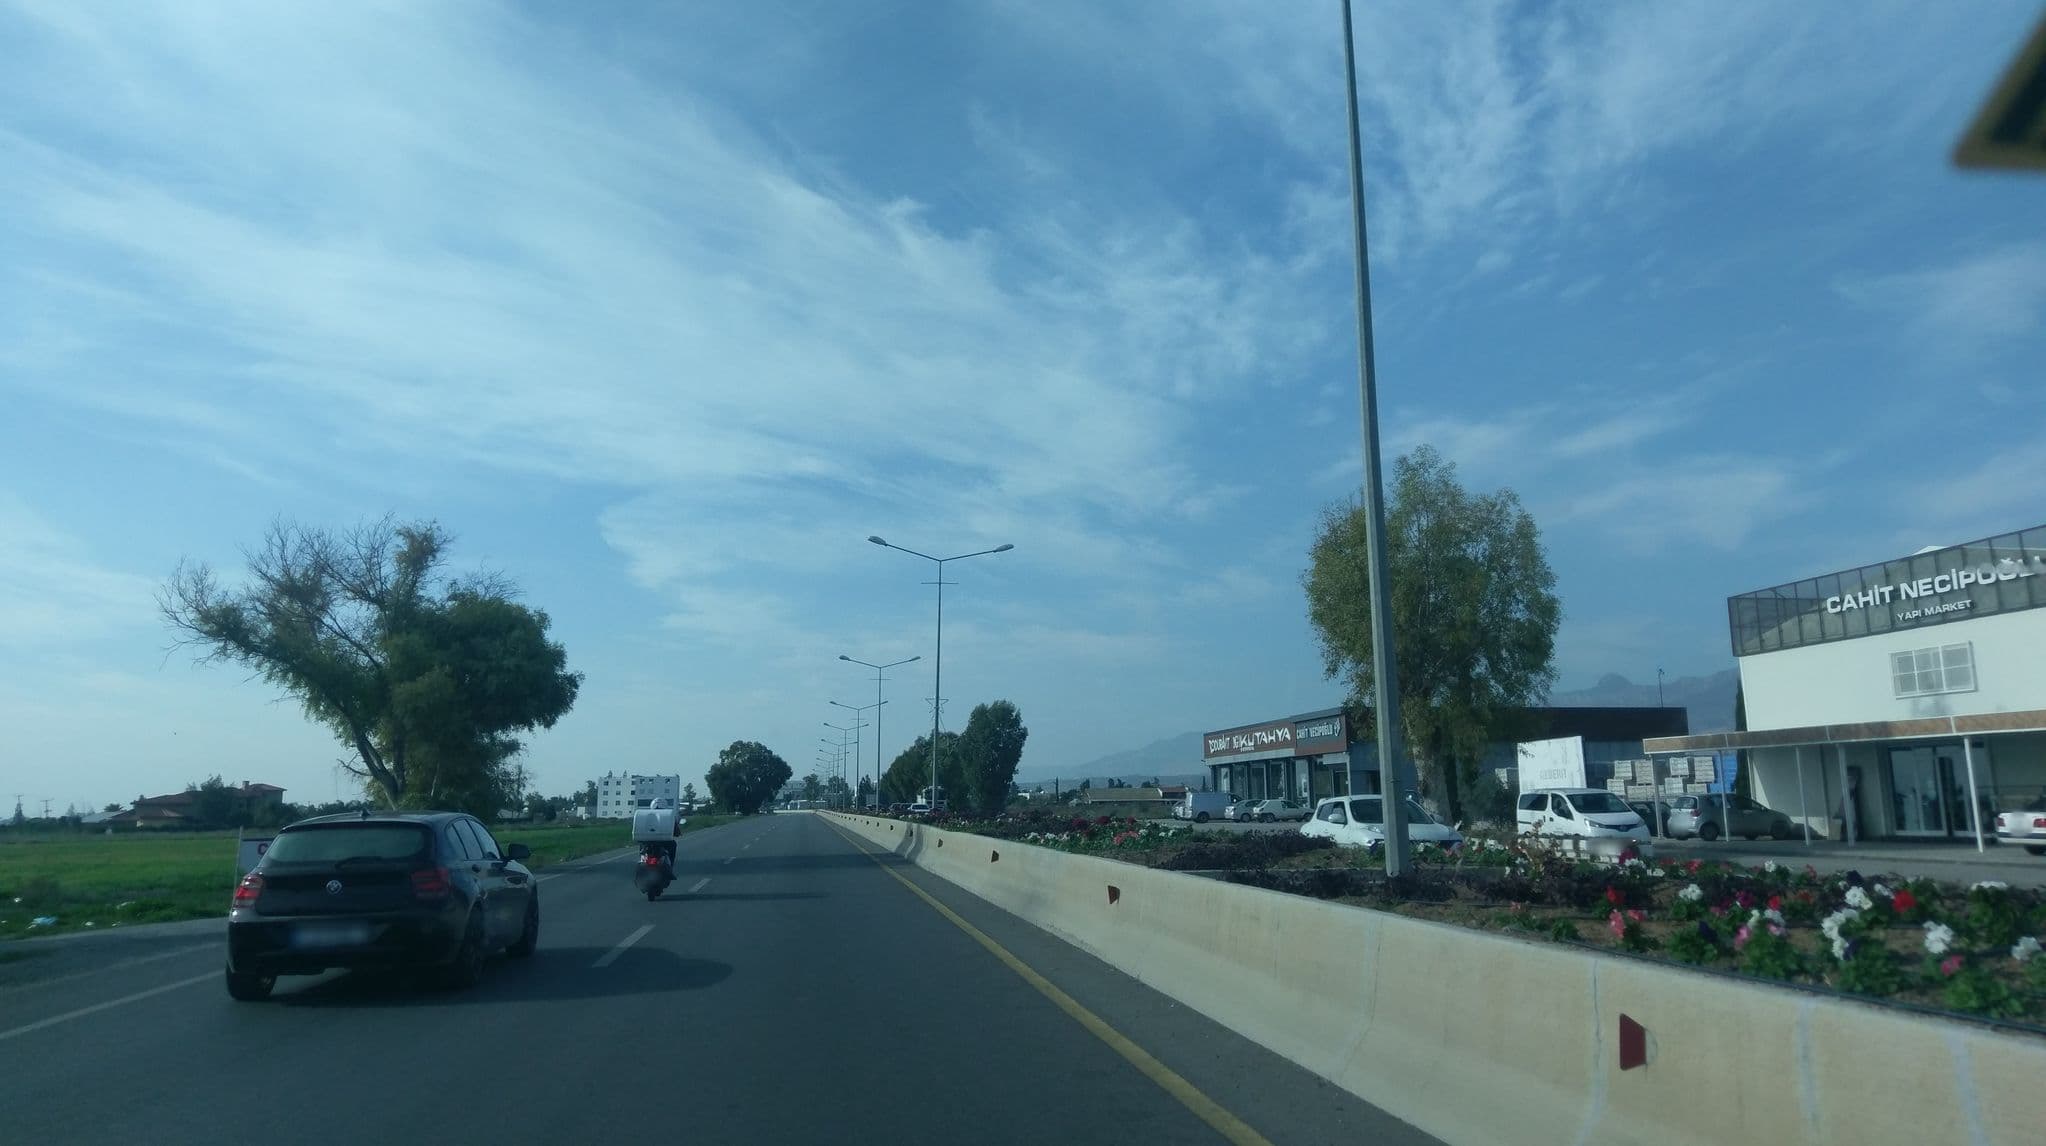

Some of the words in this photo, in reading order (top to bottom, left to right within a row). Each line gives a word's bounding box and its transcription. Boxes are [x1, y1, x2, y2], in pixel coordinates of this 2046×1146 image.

[1826, 584, 1894, 614] CAHİT
[1897, 611, 1922, 621] YAPI
[1924, 599, 1972, 617] MARKET
